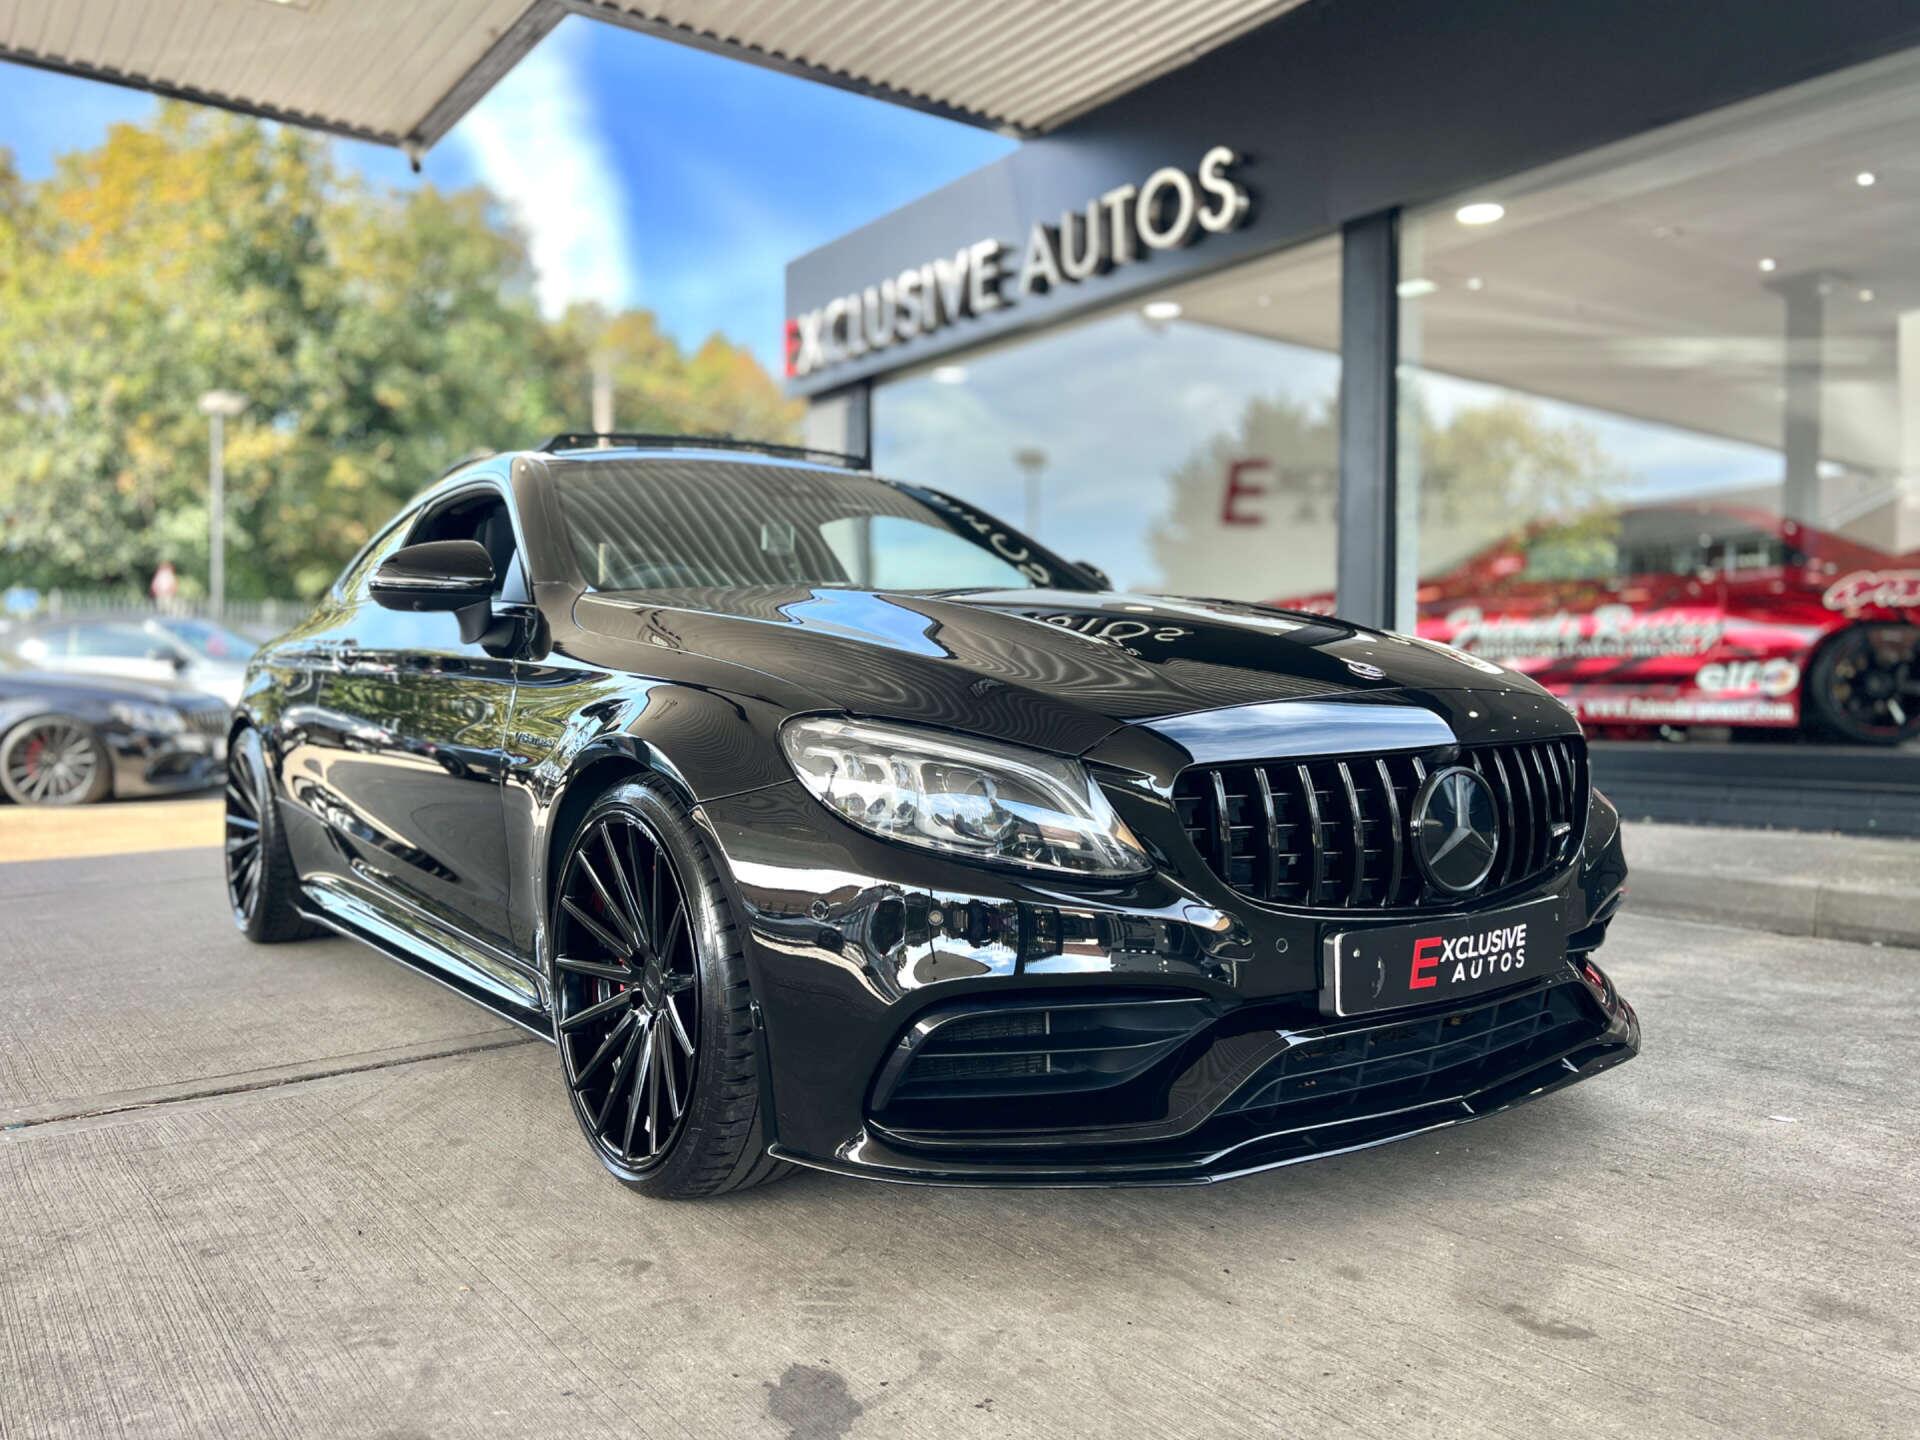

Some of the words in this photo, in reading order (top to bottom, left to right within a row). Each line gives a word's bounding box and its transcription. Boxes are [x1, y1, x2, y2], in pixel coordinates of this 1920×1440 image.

[784, 238, 1002, 377] EXCLUSIVE
[1018, 145, 1248, 294] AUTOS
[1221, 459, 1273, 527] E
[1409, 923, 1527, 990] EXCLUSIVE
[1451, 948, 1526, 983] AUTOS
